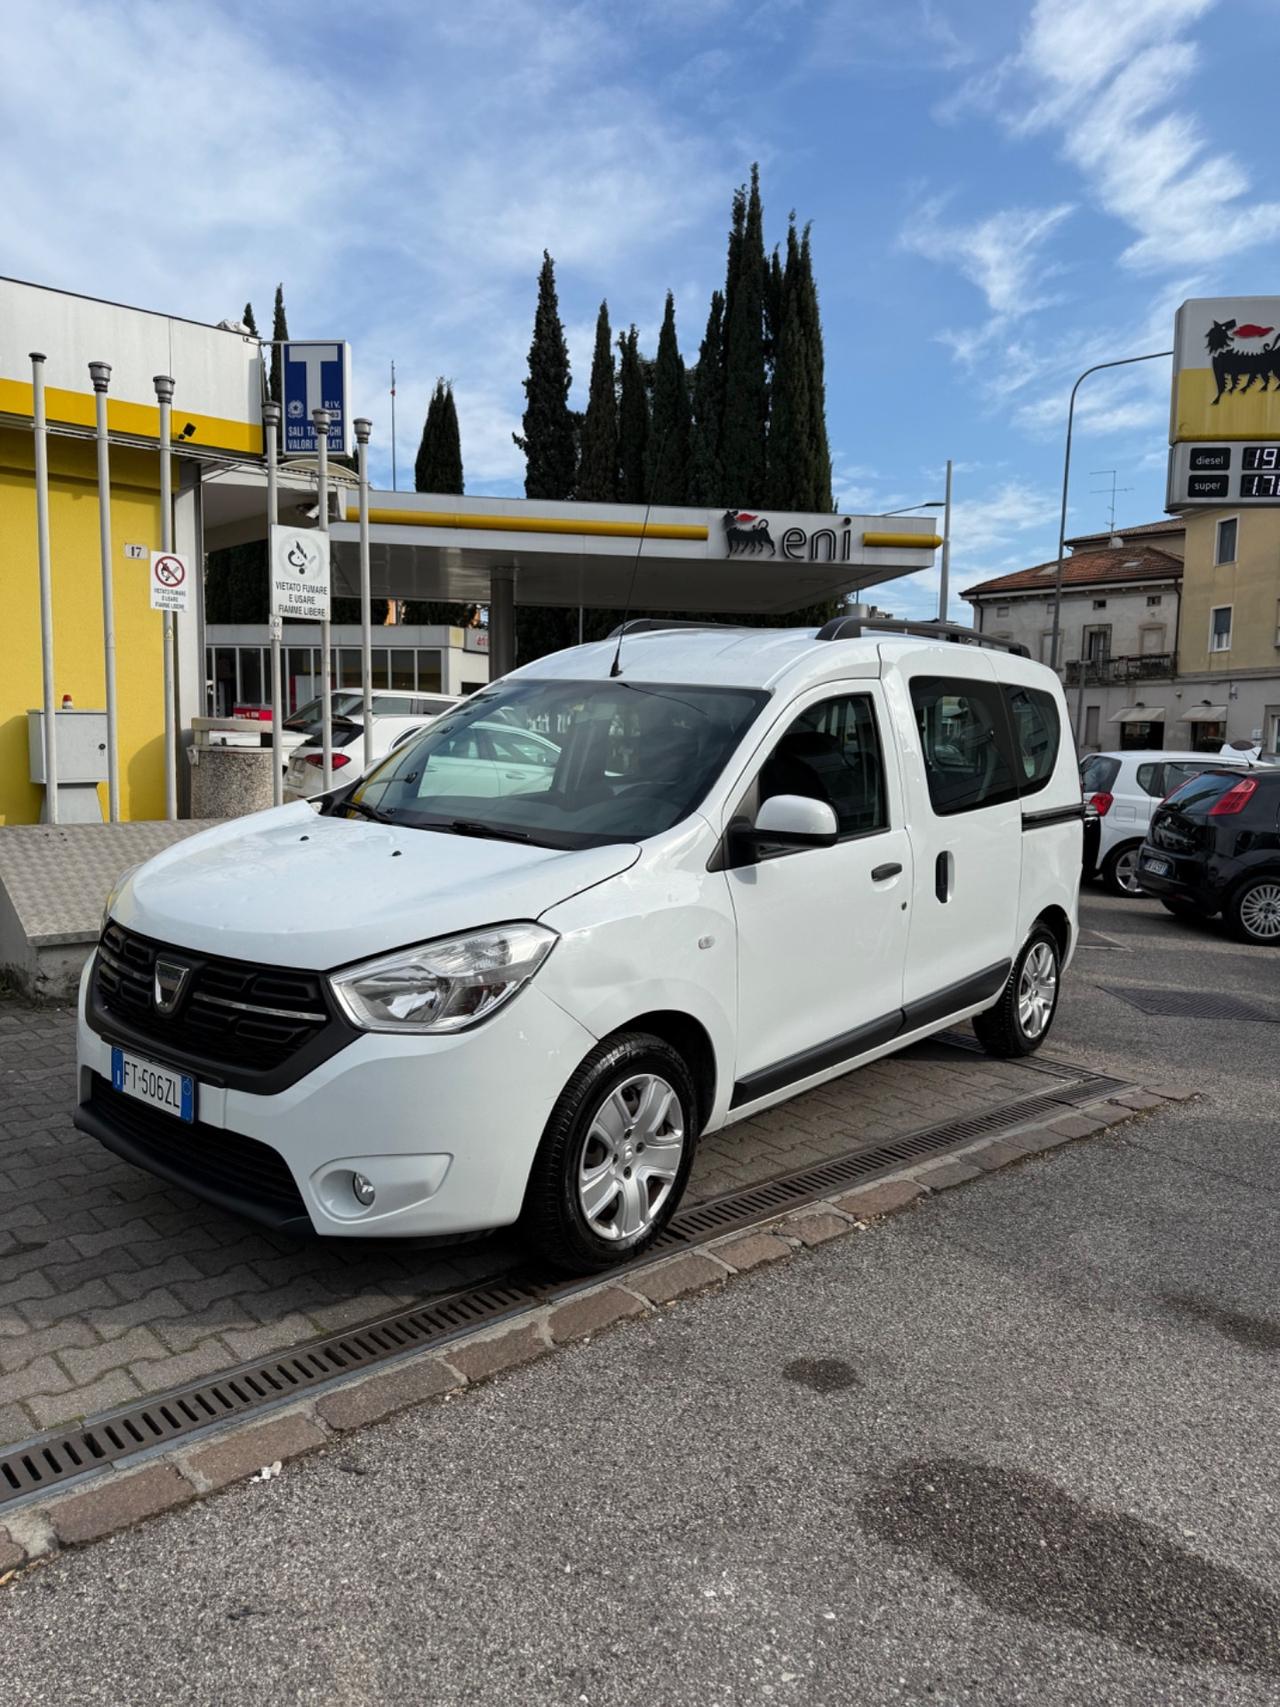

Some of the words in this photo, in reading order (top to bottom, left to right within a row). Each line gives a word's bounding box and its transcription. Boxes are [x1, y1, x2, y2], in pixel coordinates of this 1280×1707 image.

[289, 345, 338, 420] T
[288, 426, 304, 436] SALI
[307, 426, 341, 436] TACHI
[288, 438, 313, 449] VALORI
[1196, 456, 1224, 465] diesel
[1254, 448, 1280, 469] 19
[1194, 482, 1221, 493] super
[782, 517, 852, 561] eni
[131, 546, 142, 557] 17
[276, 581, 301, 592] VIETATO
[302, 584, 327, 595] FUMARE
[289, 594, 293, 602] E
[294, 594, 316, 604] USARE
[279, 604, 302, 614] FIAMME
[303, 606, 325, 617] LIBERE
